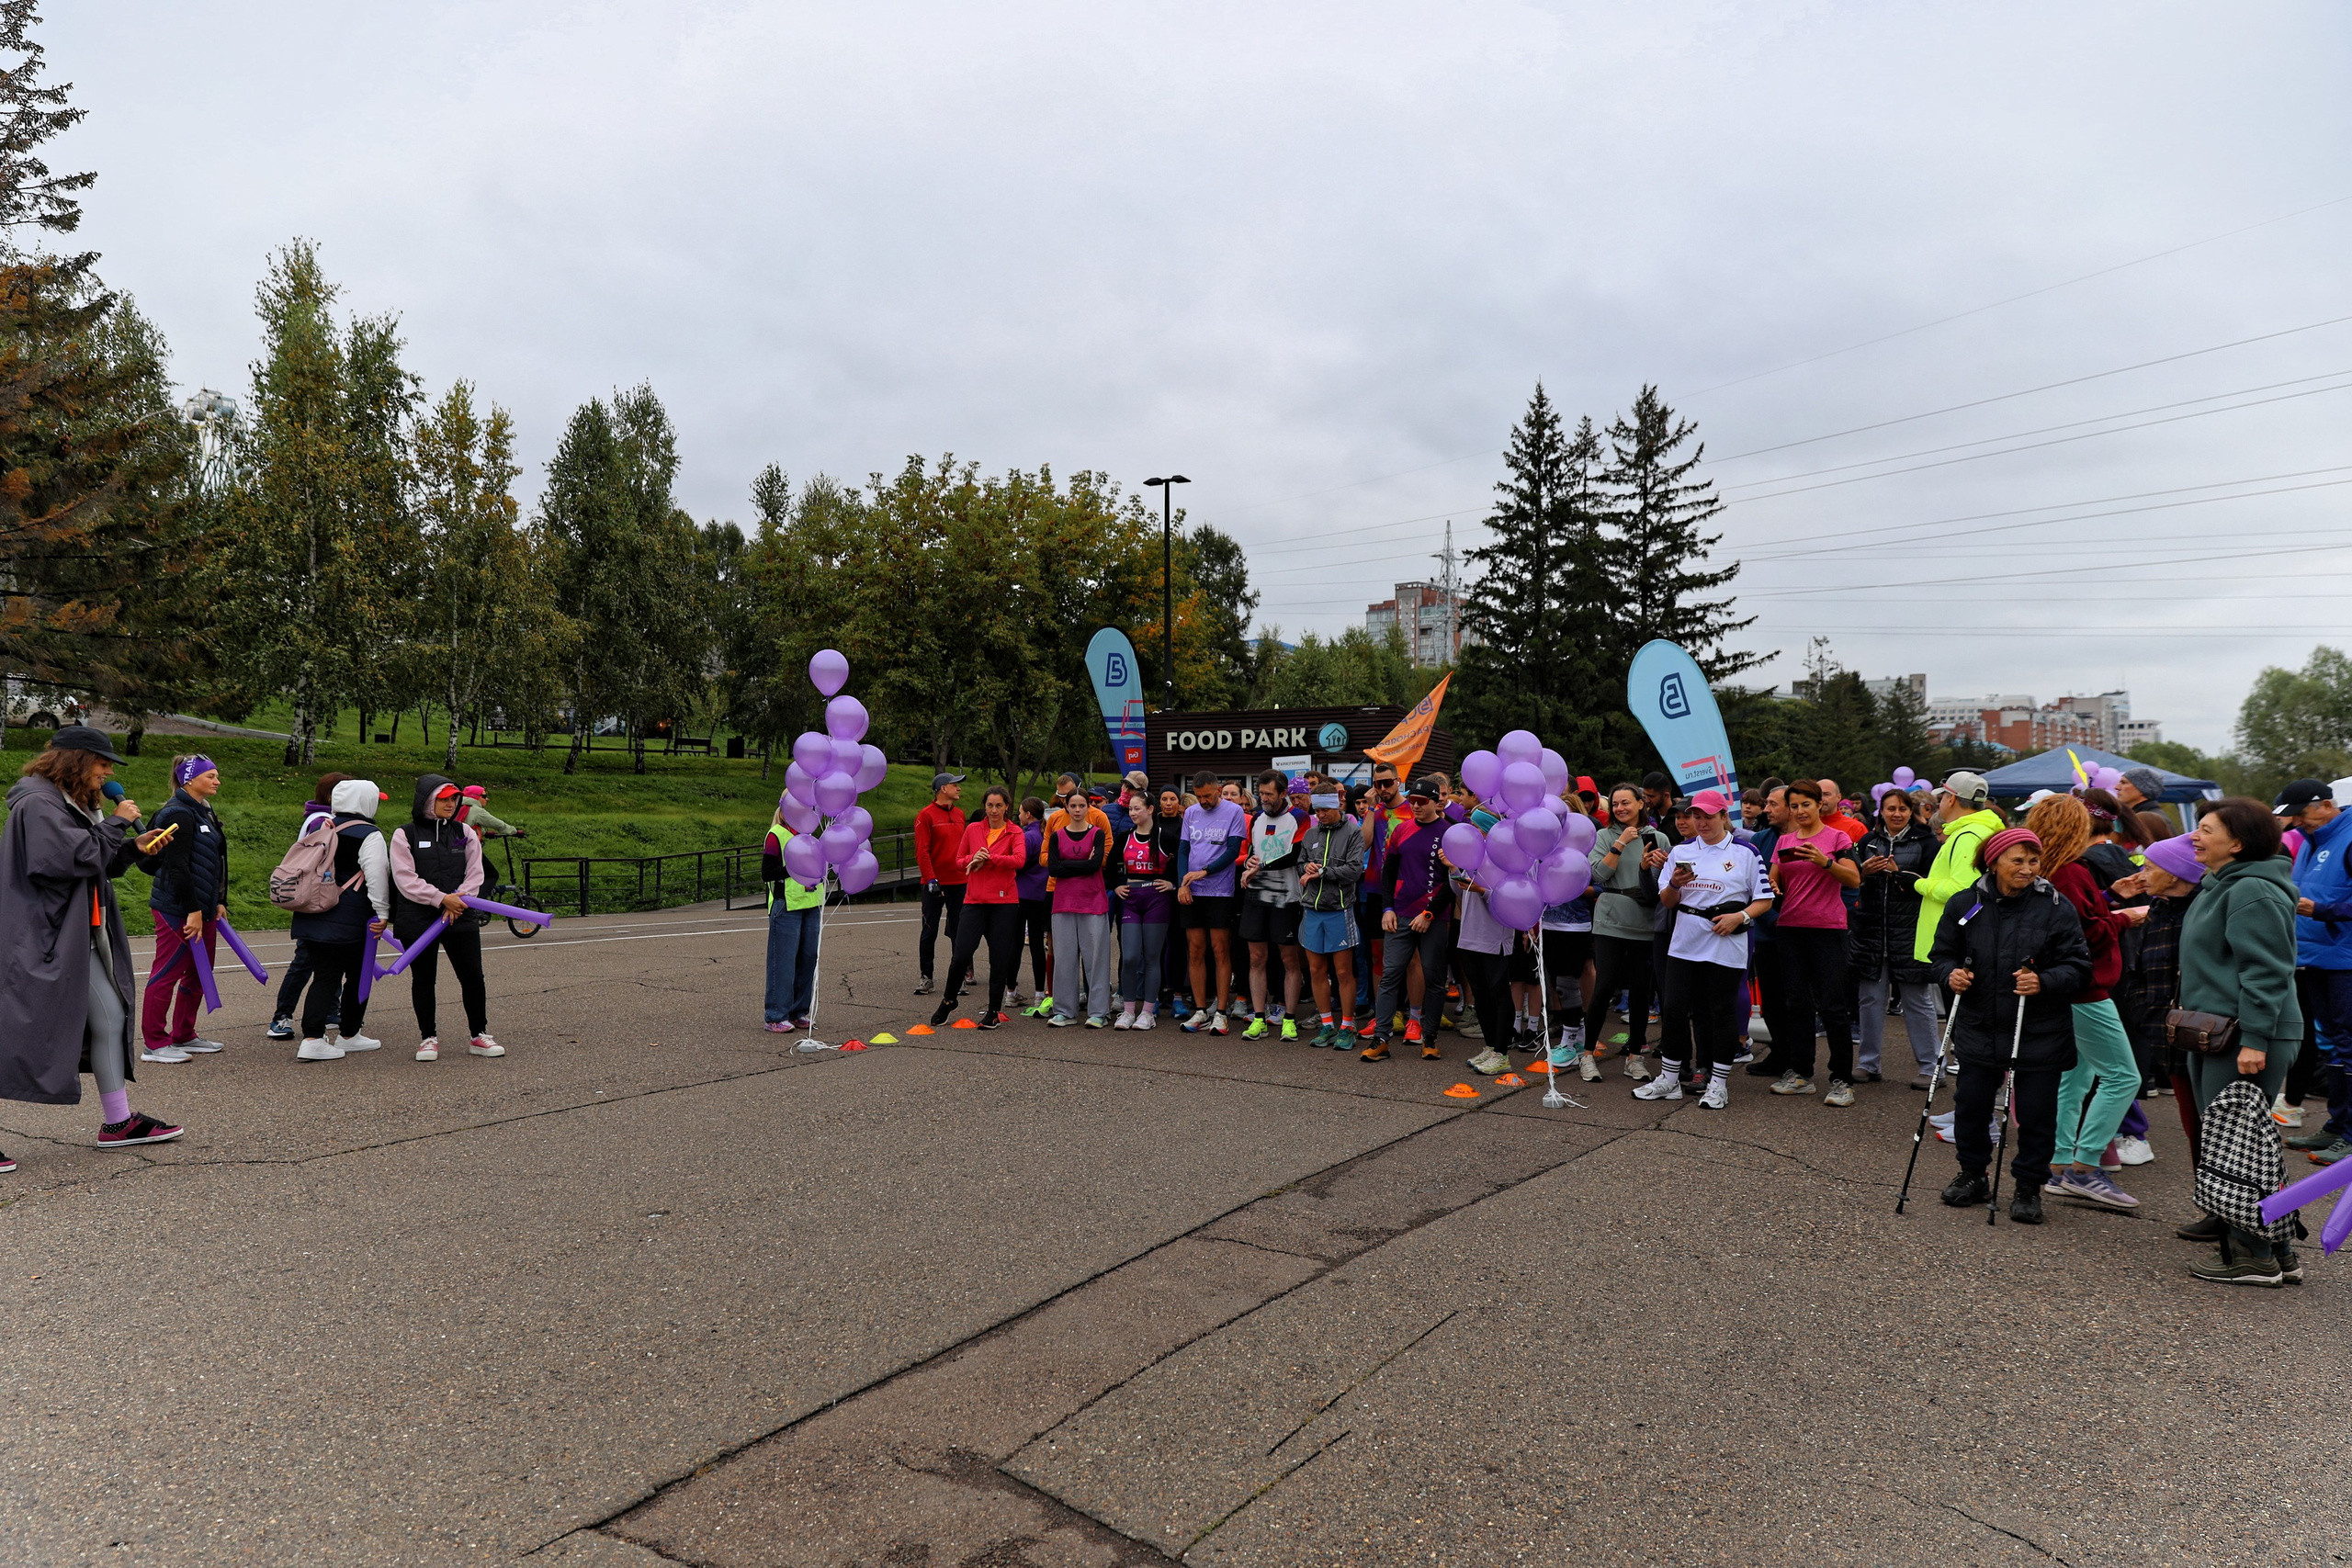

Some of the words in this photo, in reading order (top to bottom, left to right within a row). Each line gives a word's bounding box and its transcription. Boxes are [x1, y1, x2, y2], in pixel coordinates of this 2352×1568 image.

[1166, 730, 1232, 750] FOOD
[1241, 728, 1306, 749] PARK
[184, 758, 194, 784] TRAIL
[1136, 850, 1144, 860] 2
[1136, 862, 1153, 870] ВТБ
[1427, 837, 1440, 907] АСМАРАФОН
[1685, 882, 1721, 890] intendo
